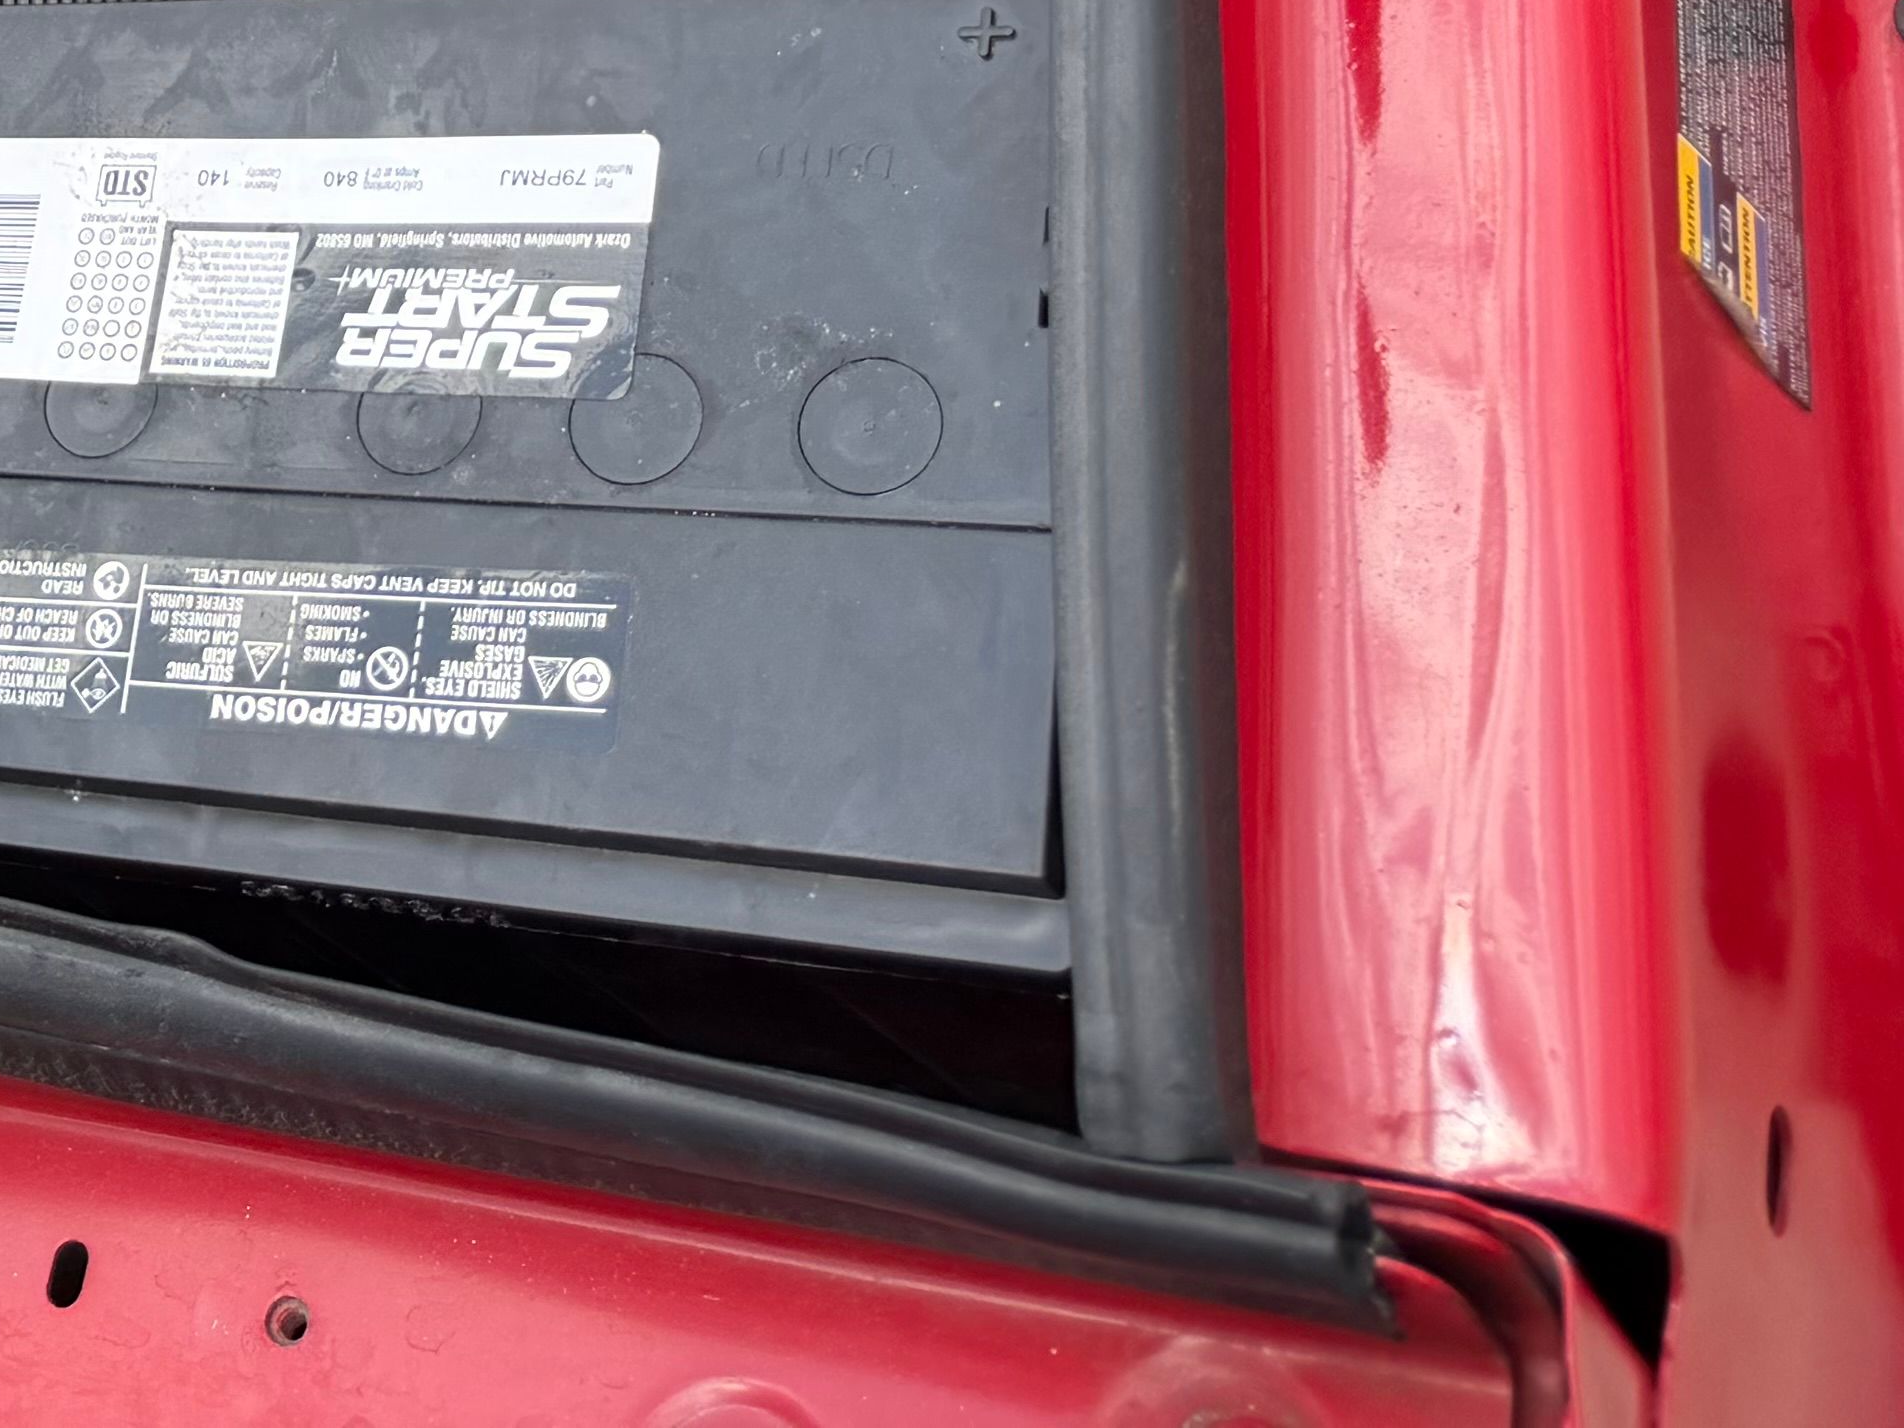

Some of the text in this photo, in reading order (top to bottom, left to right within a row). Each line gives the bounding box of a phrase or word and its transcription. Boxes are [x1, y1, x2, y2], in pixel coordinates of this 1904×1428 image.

[197, 170, 229, 186] 140
[246, 168, 281, 179] Capacity
[500, 169, 587, 186] 79PRMJ
[596, 164, 633, 175] Number
[103, 170, 149, 196] STD
[323, 171, 358, 187] 840
[594, 177, 613, 188] Part
[353, 234, 373, 247] MO
[377, 231, 444, 248] Springfield,
[448, 232, 522, 248] Distributors,
[524, 233, 593, 248] Automotive
[595, 233, 630, 248] Ozark
[340, 283, 621, 337] START
[335, 327, 579, 379] SUPER
[41, 579, 84, 595] READ
[185, 568, 577, 598] DO NOT TIP. KEEP VENT CAPS TIGHT AND LEVEL.
[148, 592, 243, 611] SEVERE BURNS.
[15, 608, 33, 623] OF
[35, 609, 78, 624] REACH
[150, 609, 241, 628] BLINDNESS OR
[300, 604, 361, 621] SMOKING
[450, 607, 607, 628] BLINDNESS OR INJURY.
[15, 625, 41, 641] OUT
[42, 627, 76, 642] KEEP
[168, 627, 239, 645] CAN CAUSE
[304, 625, 358, 642] FLAMES
[450, 625, 527, 643] CAN CAUSE
[202, 647, 237, 664] ACID
[303, 646, 356, 664] SPARKS
[474, 644, 526, 662] GASES
[45, 657, 70, 672] GET
[165, 661, 234, 682] SULFURIC
[439, 660, 523, 681] EXPLOSIVE
[36, 674, 67, 690] WITH
[339, 669, 361, 688] NO
[421, 677, 523, 700] SHIELD EYES.
[25, 691, 65, 707] FLUSH
[210, 694, 478, 734] DANGER/POISON
